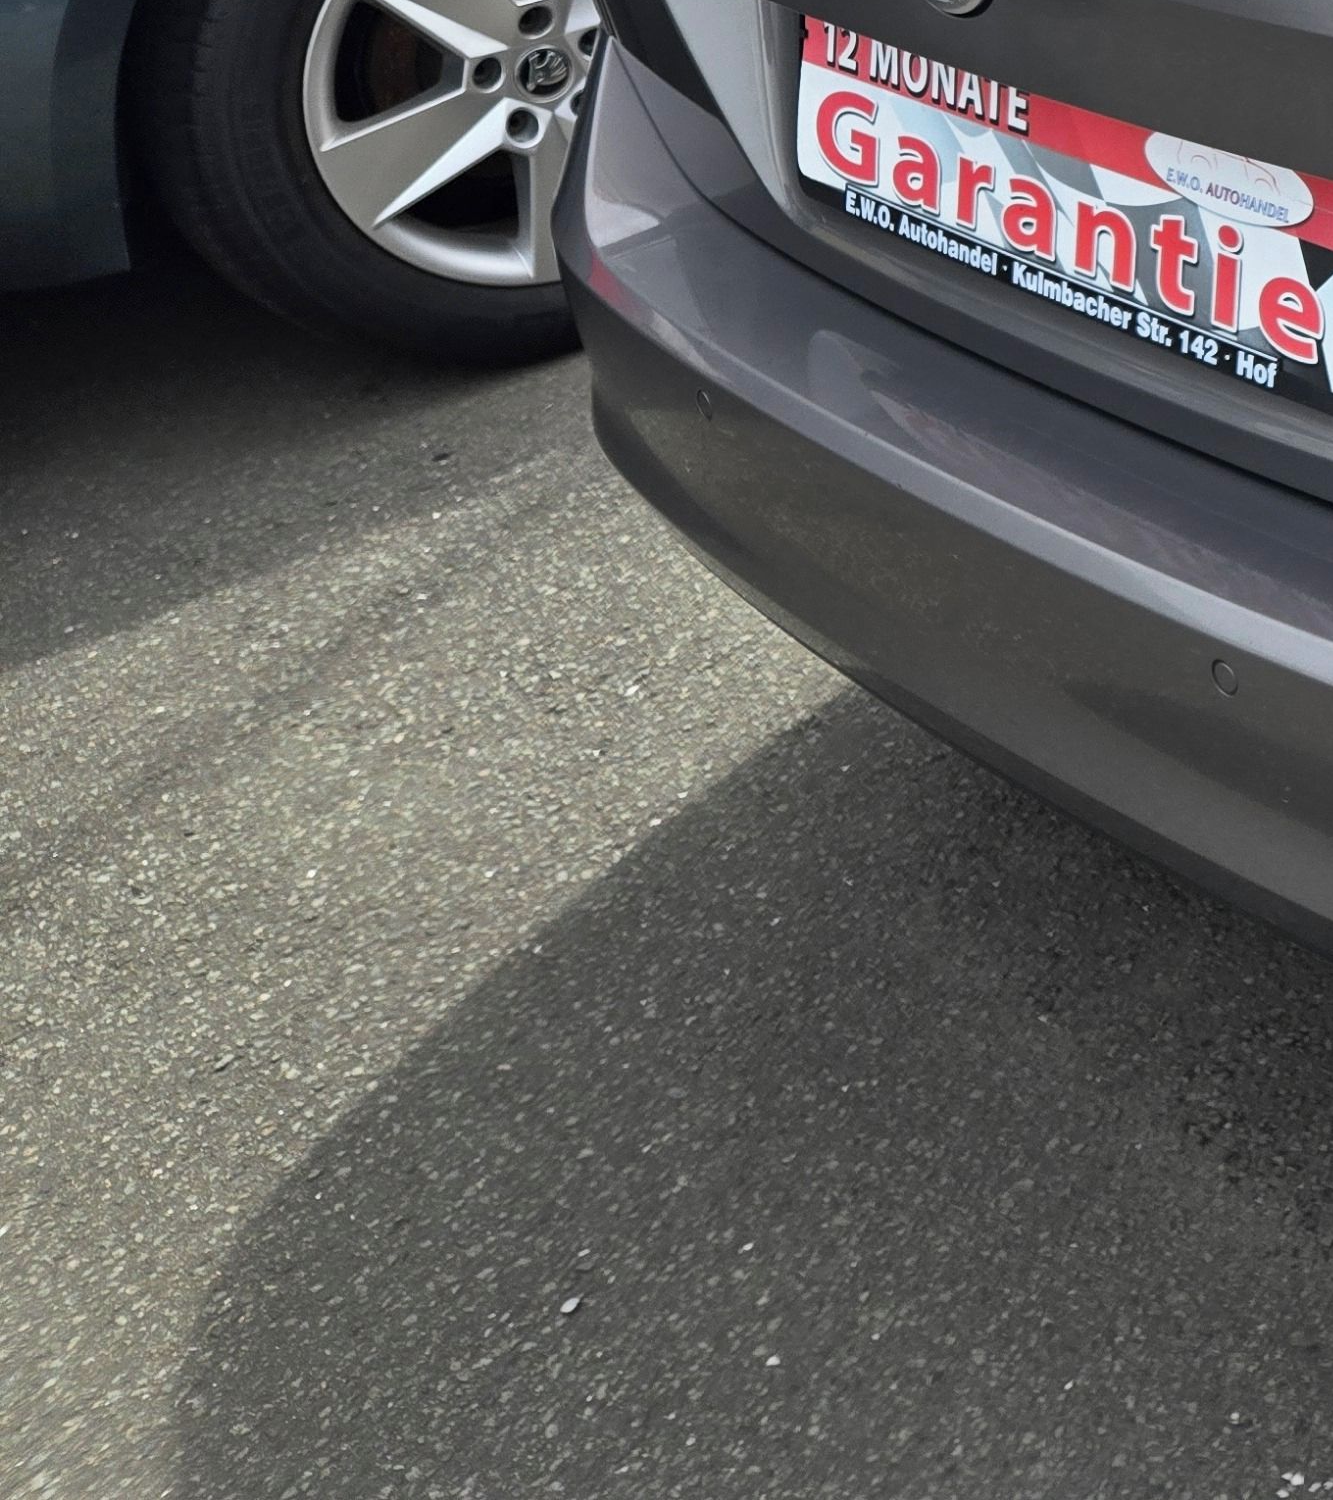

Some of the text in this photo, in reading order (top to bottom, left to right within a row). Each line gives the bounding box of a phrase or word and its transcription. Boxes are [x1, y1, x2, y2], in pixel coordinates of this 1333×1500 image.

[822, 21, 858, 75] 12
[814, 90, 1326, 365] Garantie
[1166, 167, 1290, 224] E.W.O. AUTOHANDEL
[845, 190, 1278, 389] E.W.O. Autohandel Kulmbacher Str. 142 Hof
